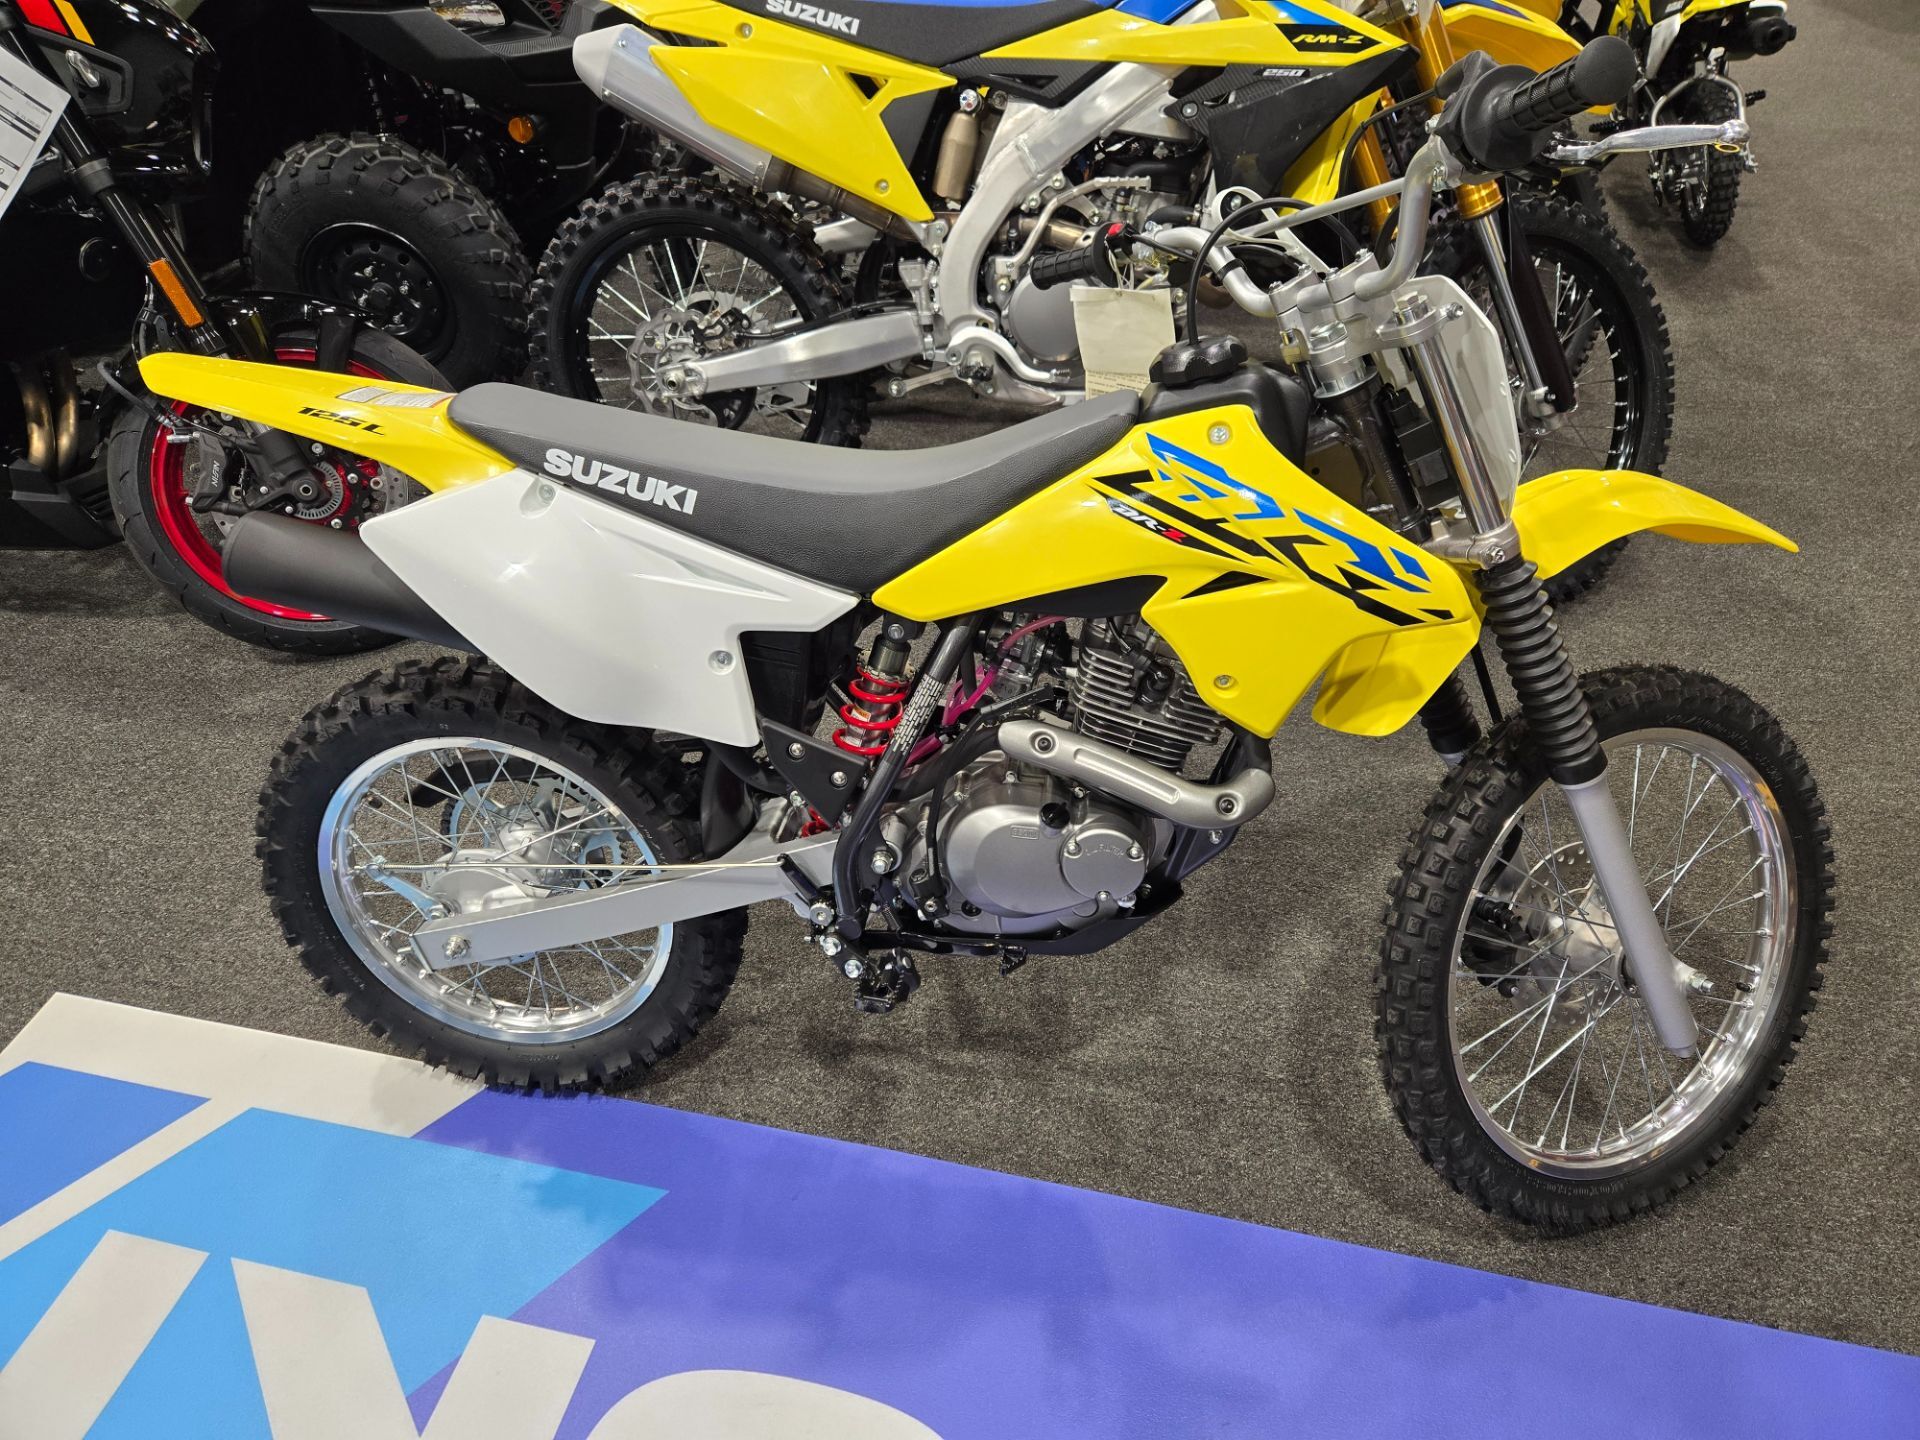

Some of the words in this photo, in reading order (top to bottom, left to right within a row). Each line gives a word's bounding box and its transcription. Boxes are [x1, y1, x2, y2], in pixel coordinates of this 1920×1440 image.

[765, 0, 860, 36] SUZUKI
[1291, 34, 1364, 44] RM-Z
[1262, 68, 1306, 77] 250
[298, 406, 384, 436] 125L
[543, 448, 698, 516] SUZUKI
